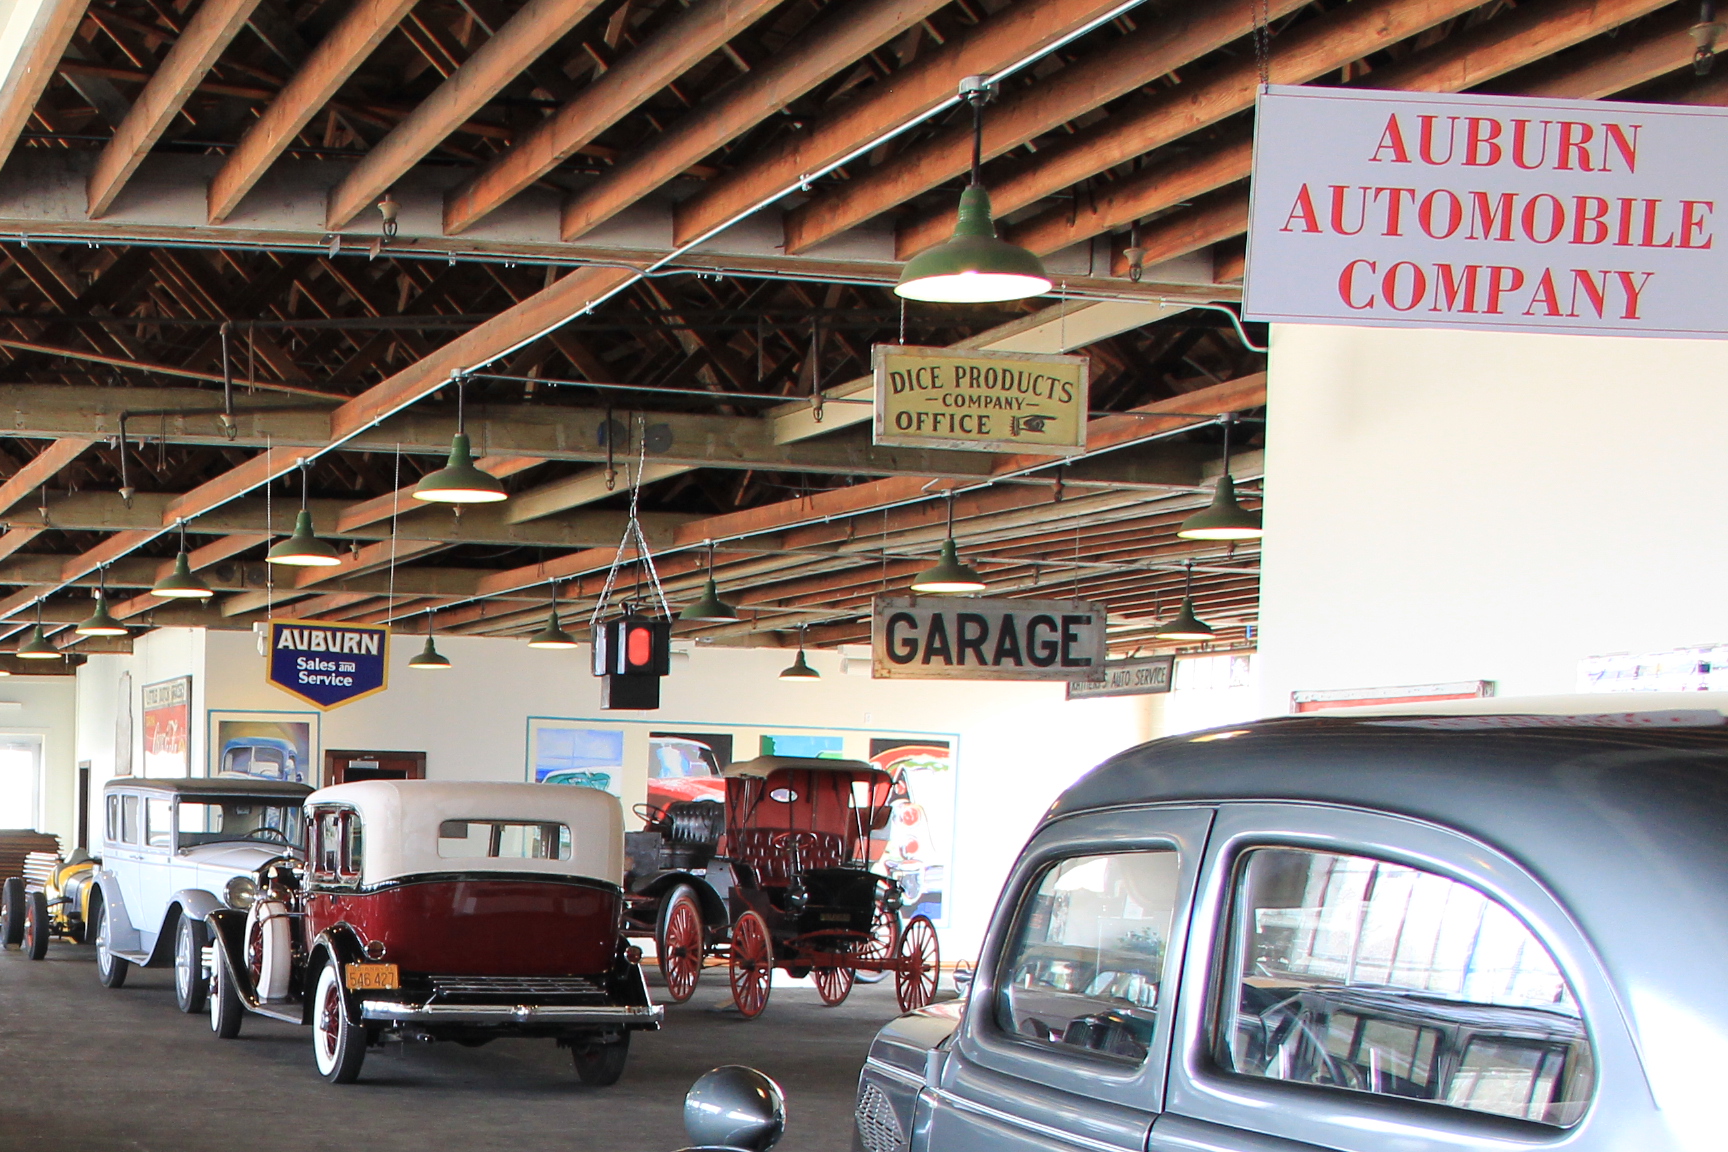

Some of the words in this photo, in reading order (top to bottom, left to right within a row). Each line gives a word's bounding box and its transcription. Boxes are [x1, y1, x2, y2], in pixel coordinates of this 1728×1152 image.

[1368, 112, 1643, 174] AUBURN
[1279, 183, 1714, 250] AUTOMOBILE
[1338, 259, 1655, 320] COMPANY
[889, 365, 944, 395] DICE
[954, 365, 1074, 404] PRODUCTS
[941, 392, 1026, 411] COMPANY
[895, 410, 992, 435] OFFICE
[276, 627, 381, 656] AUBURN
[885, 611, 1093, 668] GARAGE
[296, 656, 336, 672] Sales
[338, 661, 356, 673] and
[1111, 670, 1131, 687] AUTO
[1134, 667, 1167, 687] SERVICE
[298, 671, 354, 687] Service
[349, 972, 371, 987] 546
[374, 972, 394, 987] 427
